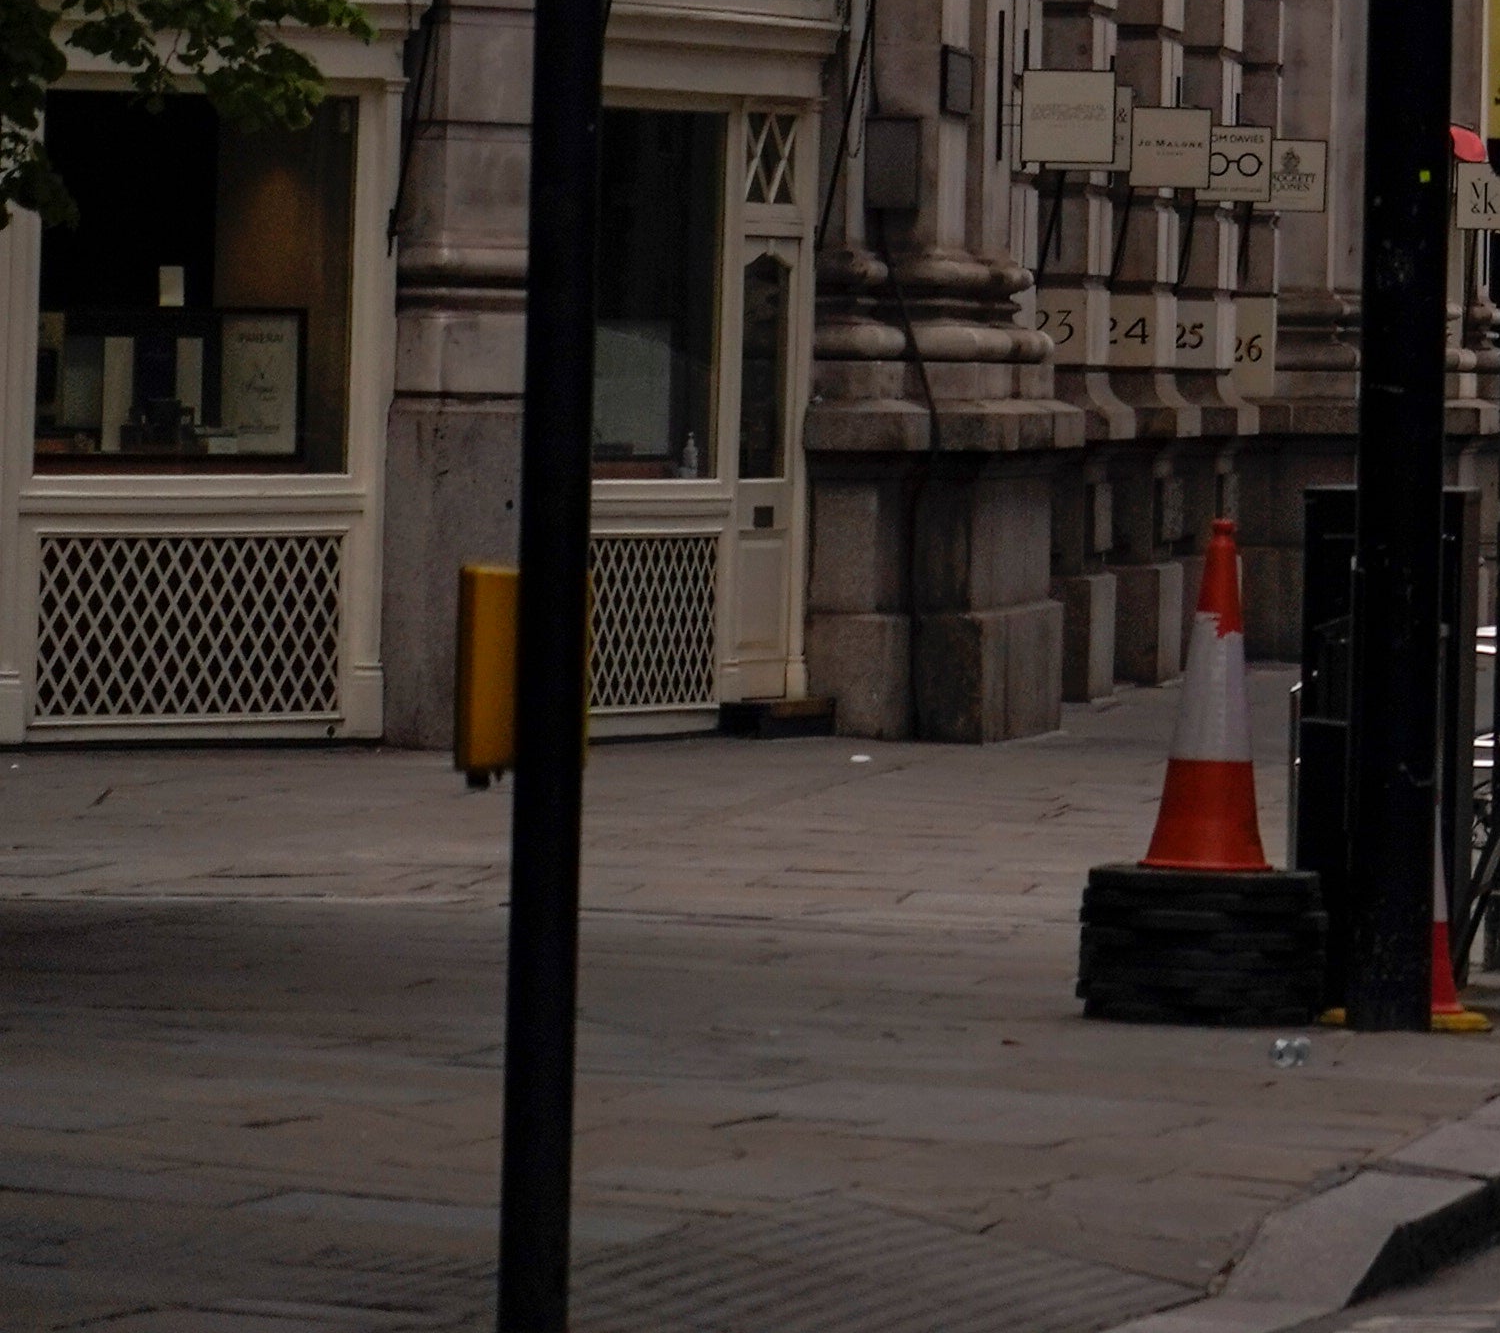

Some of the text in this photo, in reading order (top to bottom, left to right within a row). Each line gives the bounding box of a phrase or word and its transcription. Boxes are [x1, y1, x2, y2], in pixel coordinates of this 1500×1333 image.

[1210, 134, 1265, 144] OM DAVIES
[1175, 322, 1204, 349] 25
[1234, 333, 1263, 363] 26
